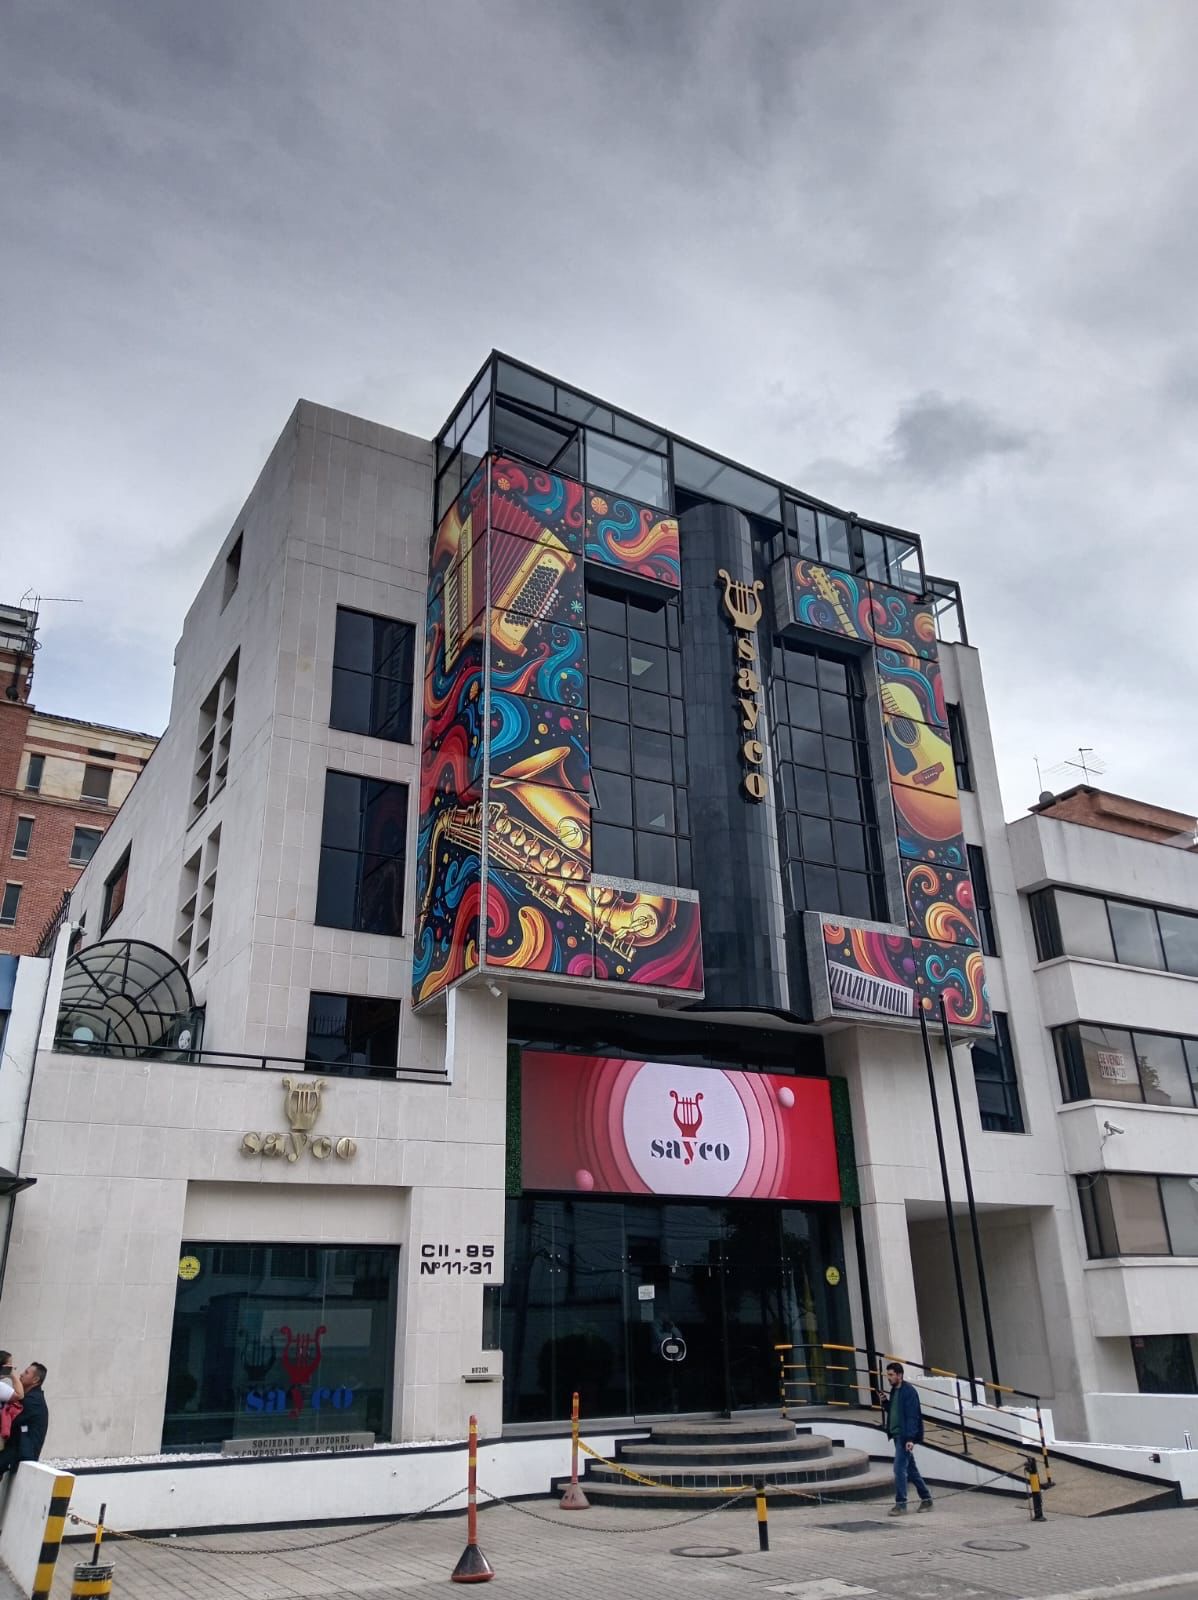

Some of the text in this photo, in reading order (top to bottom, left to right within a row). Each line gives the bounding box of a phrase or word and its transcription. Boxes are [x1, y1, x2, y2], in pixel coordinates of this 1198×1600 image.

[738, 637, 768, 799] sayco
[241, 1131, 357, 1162] sayco
[650, 1139, 730, 1165] sayco
[466, 1245, 495, 1258] 95
[246, 1385, 353, 1420] sayco
[252, 1435, 350, 1448] SOCIEDAD DE AUTORES
